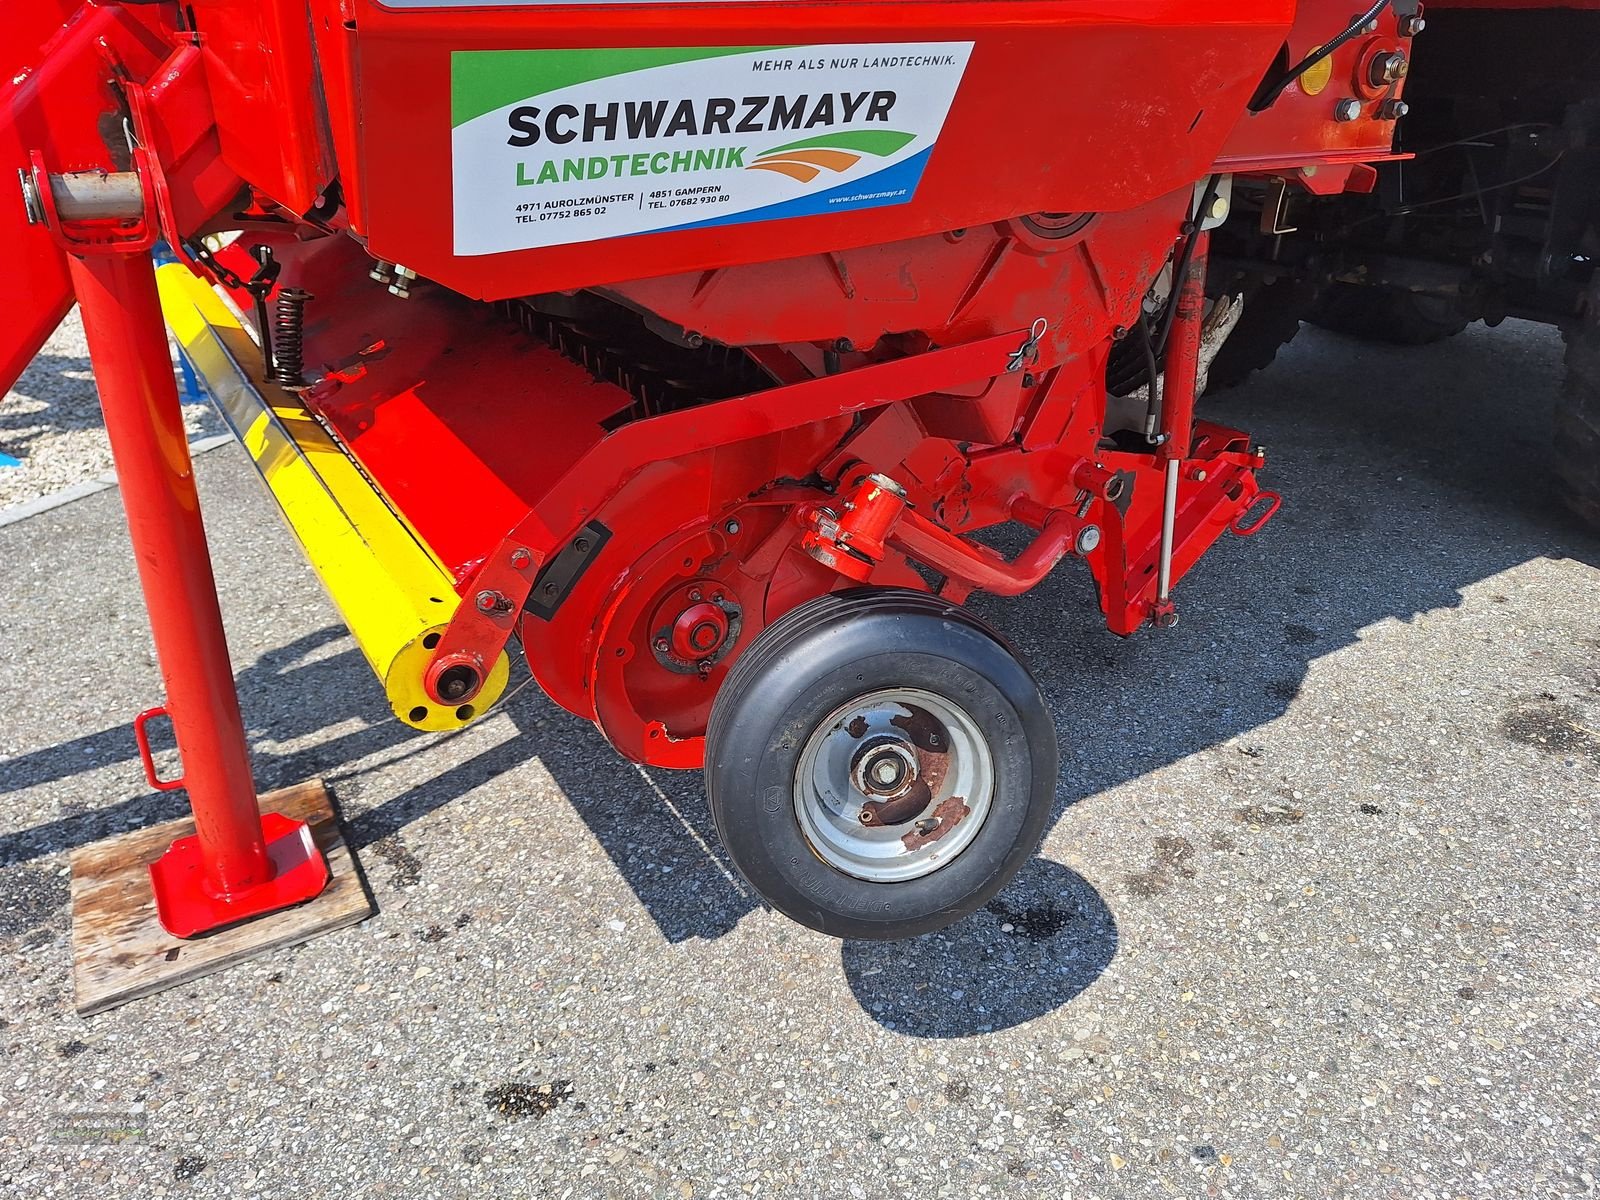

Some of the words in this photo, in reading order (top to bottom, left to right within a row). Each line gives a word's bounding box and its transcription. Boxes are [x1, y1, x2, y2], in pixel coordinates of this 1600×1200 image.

[752, 60, 793, 71] MEHR
[797, 58, 825, 70] ALS
[829, 57, 859, 69] NUR
[862, 55, 956, 68] LANDTECHNIK.
[507, 90, 897, 147] SCHWARZMAYR
[516, 146, 748, 186] LANDTECHNIK
[649, 189, 672, 199] 4851
[674, 185, 722, 197] GAMPERN
[828, 188, 907, 205] www.schwarzmayr.at
[515, 202, 541, 212] 4971
[543, 192, 635, 209] AUROLZMÜNSTER
[648, 200, 667, 209] TEL.
[669, 197, 698, 207] 07682
[699, 195, 717, 205] 930
[718, 194, 730, 203] 80
[515, 214, 537, 224] TEL.
[539, 210, 571, 221] 07752
[573, 208, 592, 217] 865
[594, 206, 607, 215] 02
